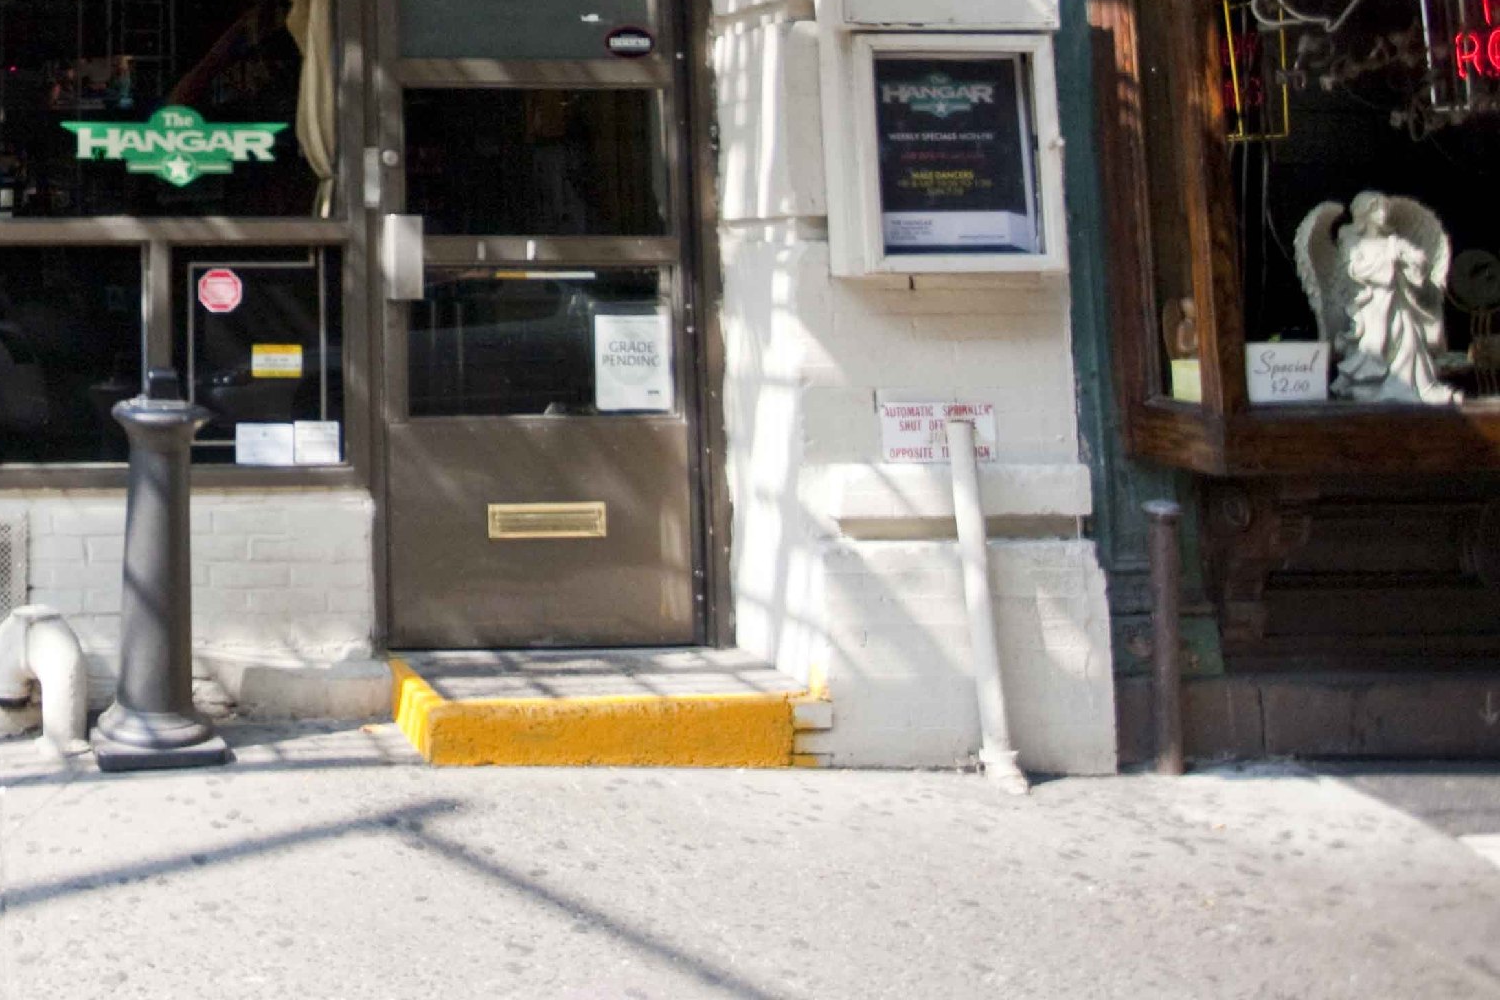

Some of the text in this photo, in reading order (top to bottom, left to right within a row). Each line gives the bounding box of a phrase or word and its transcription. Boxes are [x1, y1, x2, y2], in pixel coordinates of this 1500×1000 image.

[882, 84, 994, 104] HANGAR
[162, 112, 193, 128] The
[76, 128, 276, 162] HANGAR
[608, 341, 654, 353] GRADE
[602, 354, 660, 367] PENDING
[1253, 350, 1319, 379] Special
[884, 404, 993, 417] AUTOMATIC SPRINKLER
[899, 420, 921, 431] SHUT
[889, 447, 934, 459] OPPOSITE
